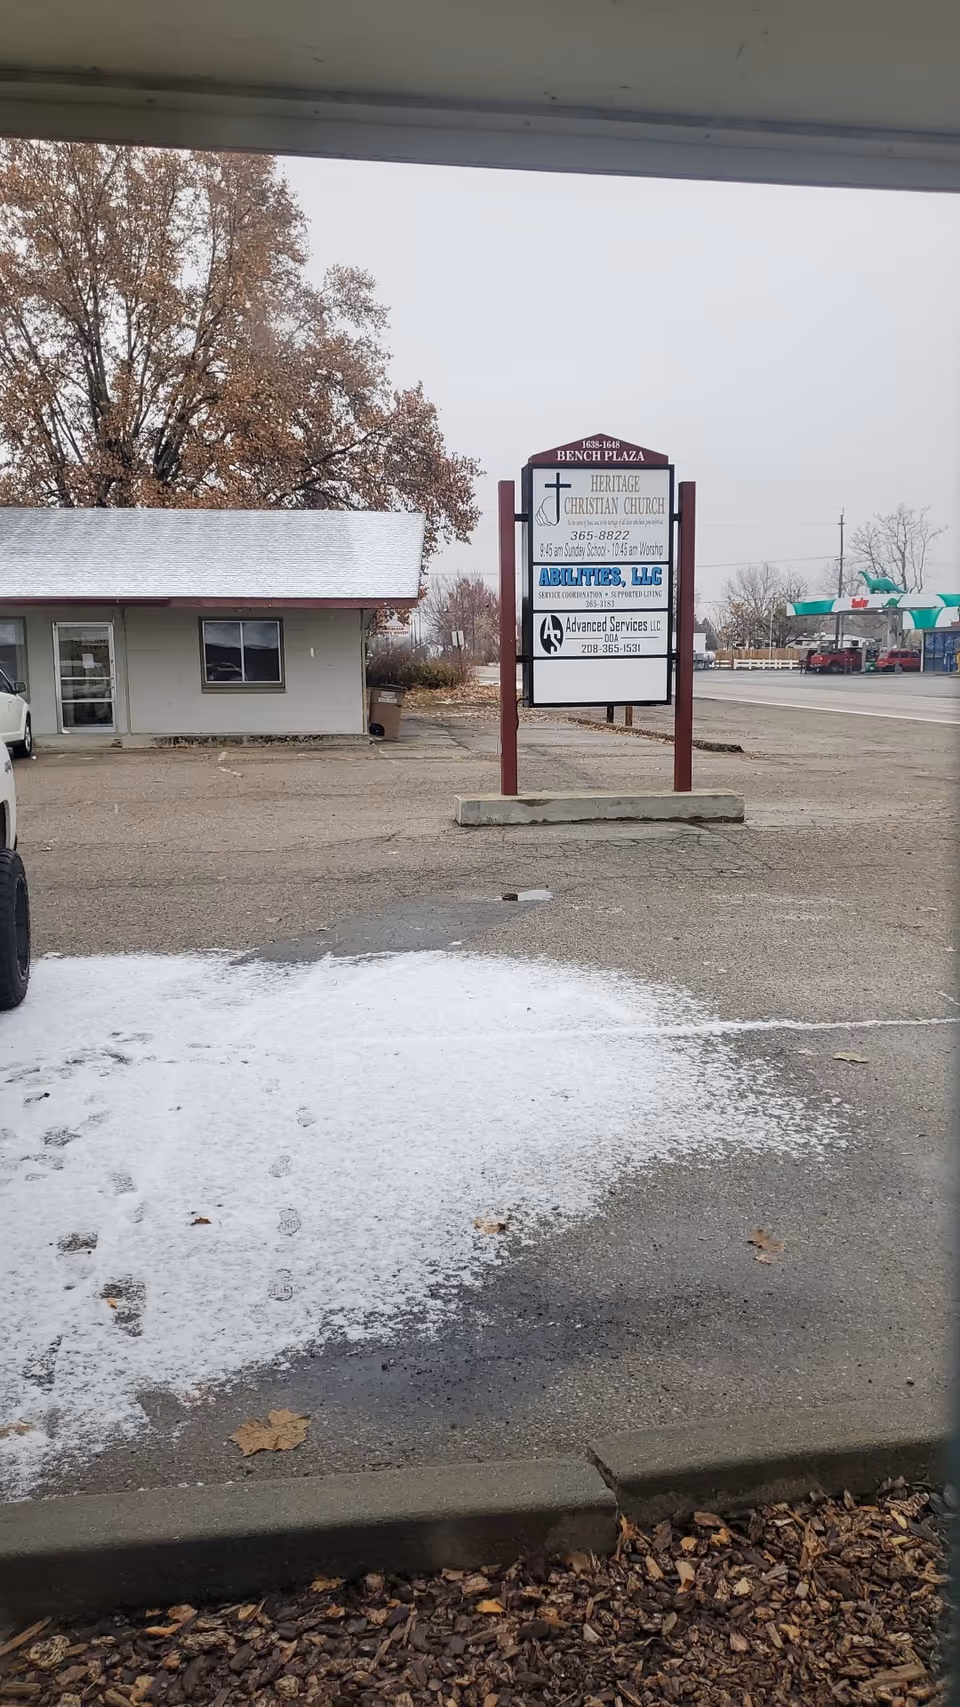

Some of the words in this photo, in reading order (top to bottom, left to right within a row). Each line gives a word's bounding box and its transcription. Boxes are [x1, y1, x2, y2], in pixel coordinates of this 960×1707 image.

[582, 440, 620, 448] 1638-1648
[557, 451, 601, 461] BENCH
[604, 451, 645, 461] PLAZA
[591, 475, 640, 492] HERITAGE
[564, 497, 618, 515] CHRISTIAN
[624, 497, 665, 514] CHURCH
[570, 531, 630, 540] 365-8822
[540, 543, 552, 557] 9:45
[554, 546, 563, 556] am
[564, 543, 585, 559] Sunday
[587, 542, 606, 557] School
[612, 543, 627, 556] 10:45
[629, 546, 638, 556] am
[639, 542, 663, 558] Worship
[539, 567, 626, 587] ABILITIES,
[631, 567, 662, 586] LLC
[566, 617, 607, 632] Advanced
[610, 616, 647, 632] Services
[581, 644, 641, 653] 208-365-1531
